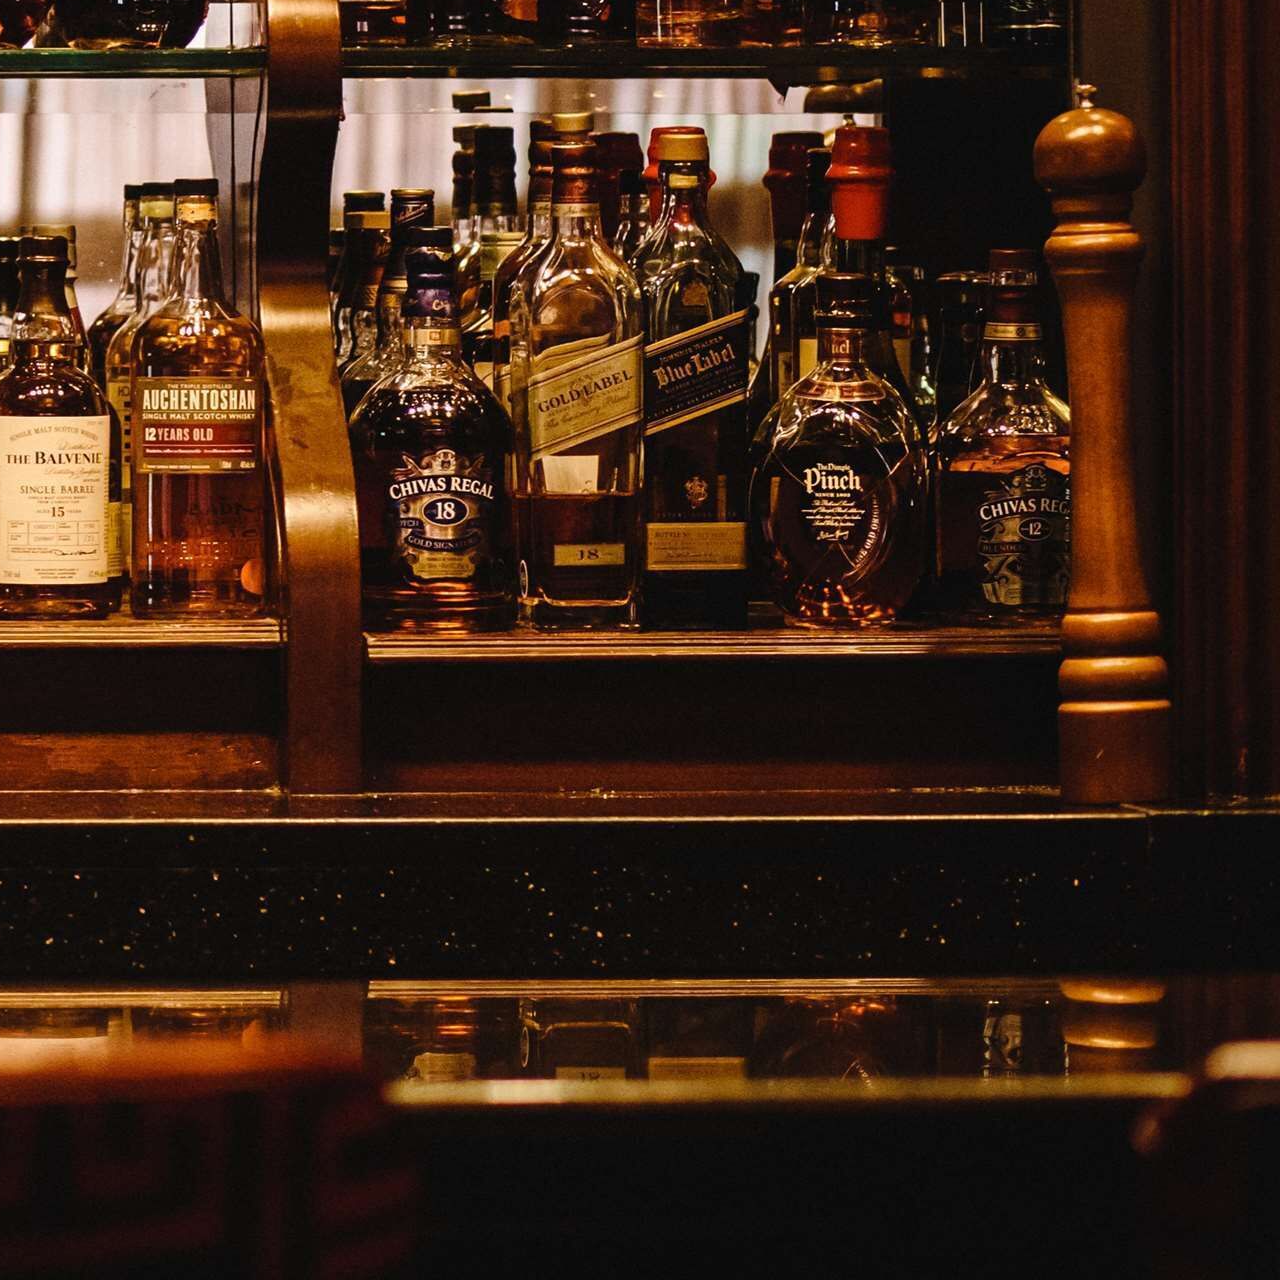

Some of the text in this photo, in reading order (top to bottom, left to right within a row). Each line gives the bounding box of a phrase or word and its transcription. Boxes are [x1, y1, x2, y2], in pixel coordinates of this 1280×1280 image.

[652, 344, 737, 389] Blue Label
[538, 391, 580, 414] GOLD
[584, 370, 634, 397] LABEL
[142, 389, 256, 411] AUCHENTOSHAN
[142, 412, 255, 420] SINGLE MALT SCOTCH WHISKY
[33, 426, 53, 435] MALT
[144, 427, 214, 442] 12 YEARS OLD
[5, 451, 103, 465] THE BALVENIE
[389, 476, 494, 500] CHIVAS REGAL
[803, 468, 862, 494] Pinch
[19, 485, 95, 495] SINGLE BARREL
[50, 506, 65, 518] 15
[434, 501, 456, 521] 18
[979, 498, 1037, 521] CHIVAS
[1028, 521, 1042, 536] 12
[407, 535, 433, 548] GOLD
[575, 549, 600, 561] 18
